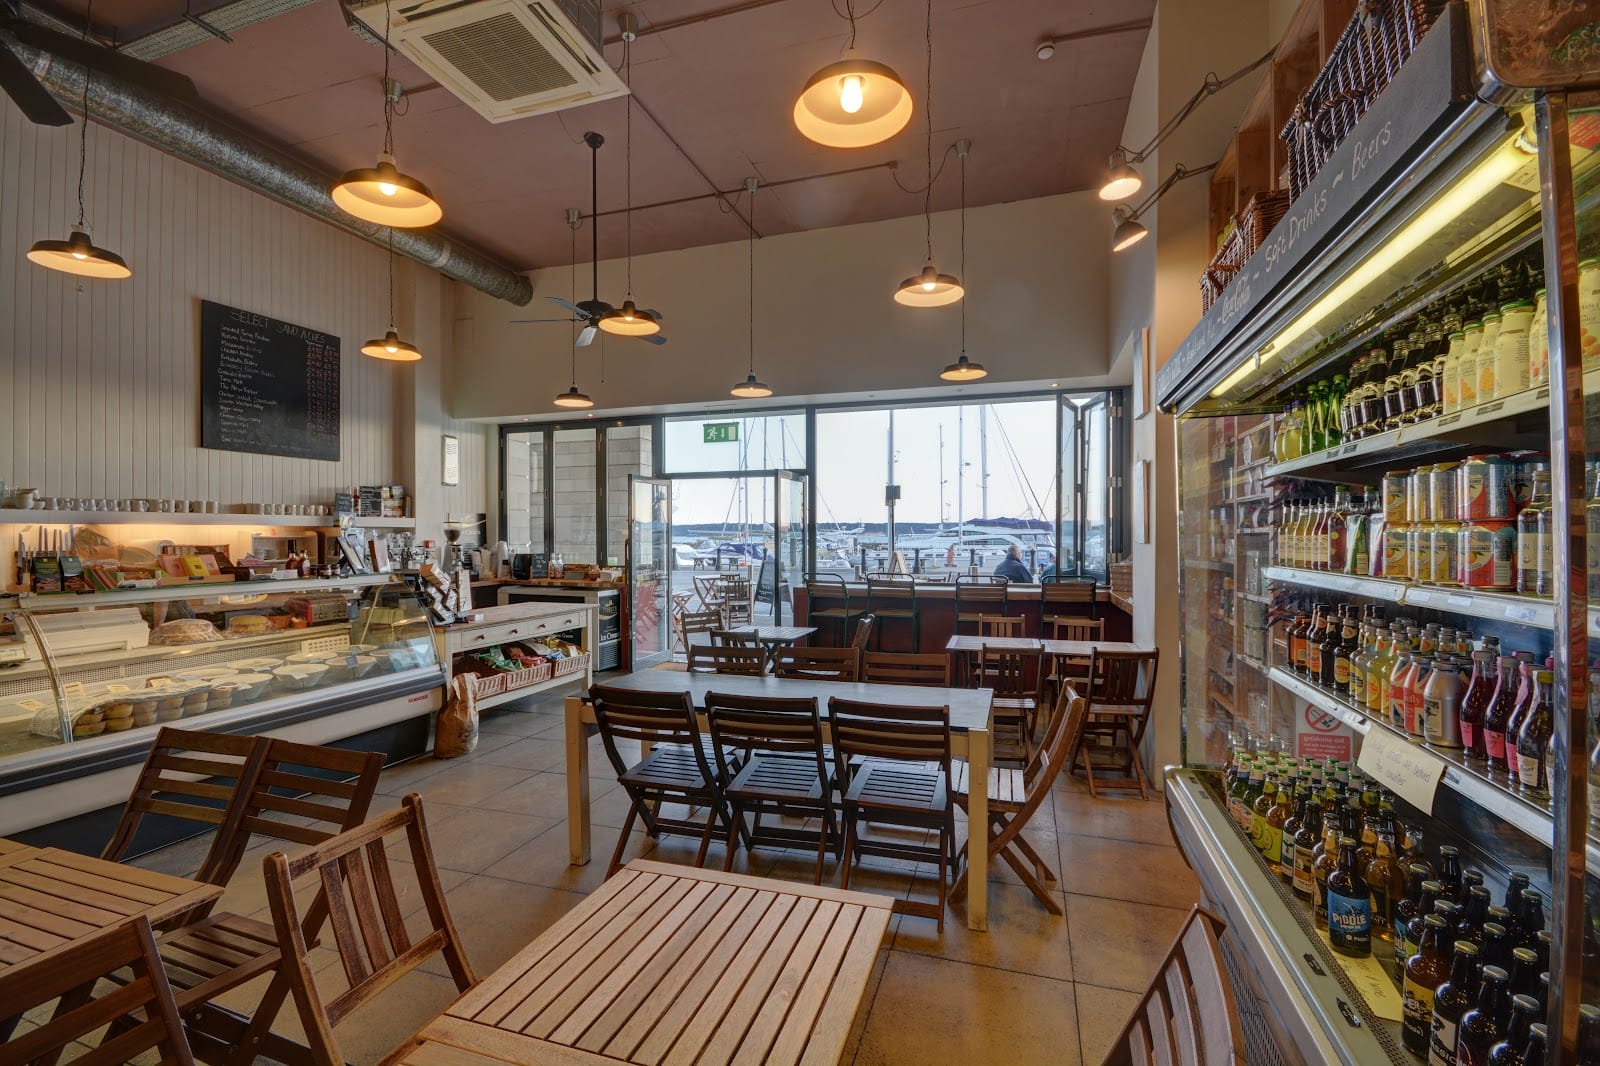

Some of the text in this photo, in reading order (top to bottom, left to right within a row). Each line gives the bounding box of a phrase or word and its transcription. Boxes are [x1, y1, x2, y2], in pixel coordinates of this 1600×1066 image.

[1265, 232, 1287, 273] Soft
[1288, 189, 1327, 249] Drinks
[1351, 121, 1392, 182] Beers
[231, 310, 269, 329] SELECT
[1332, 911, 1367, 925] PIDDLE
